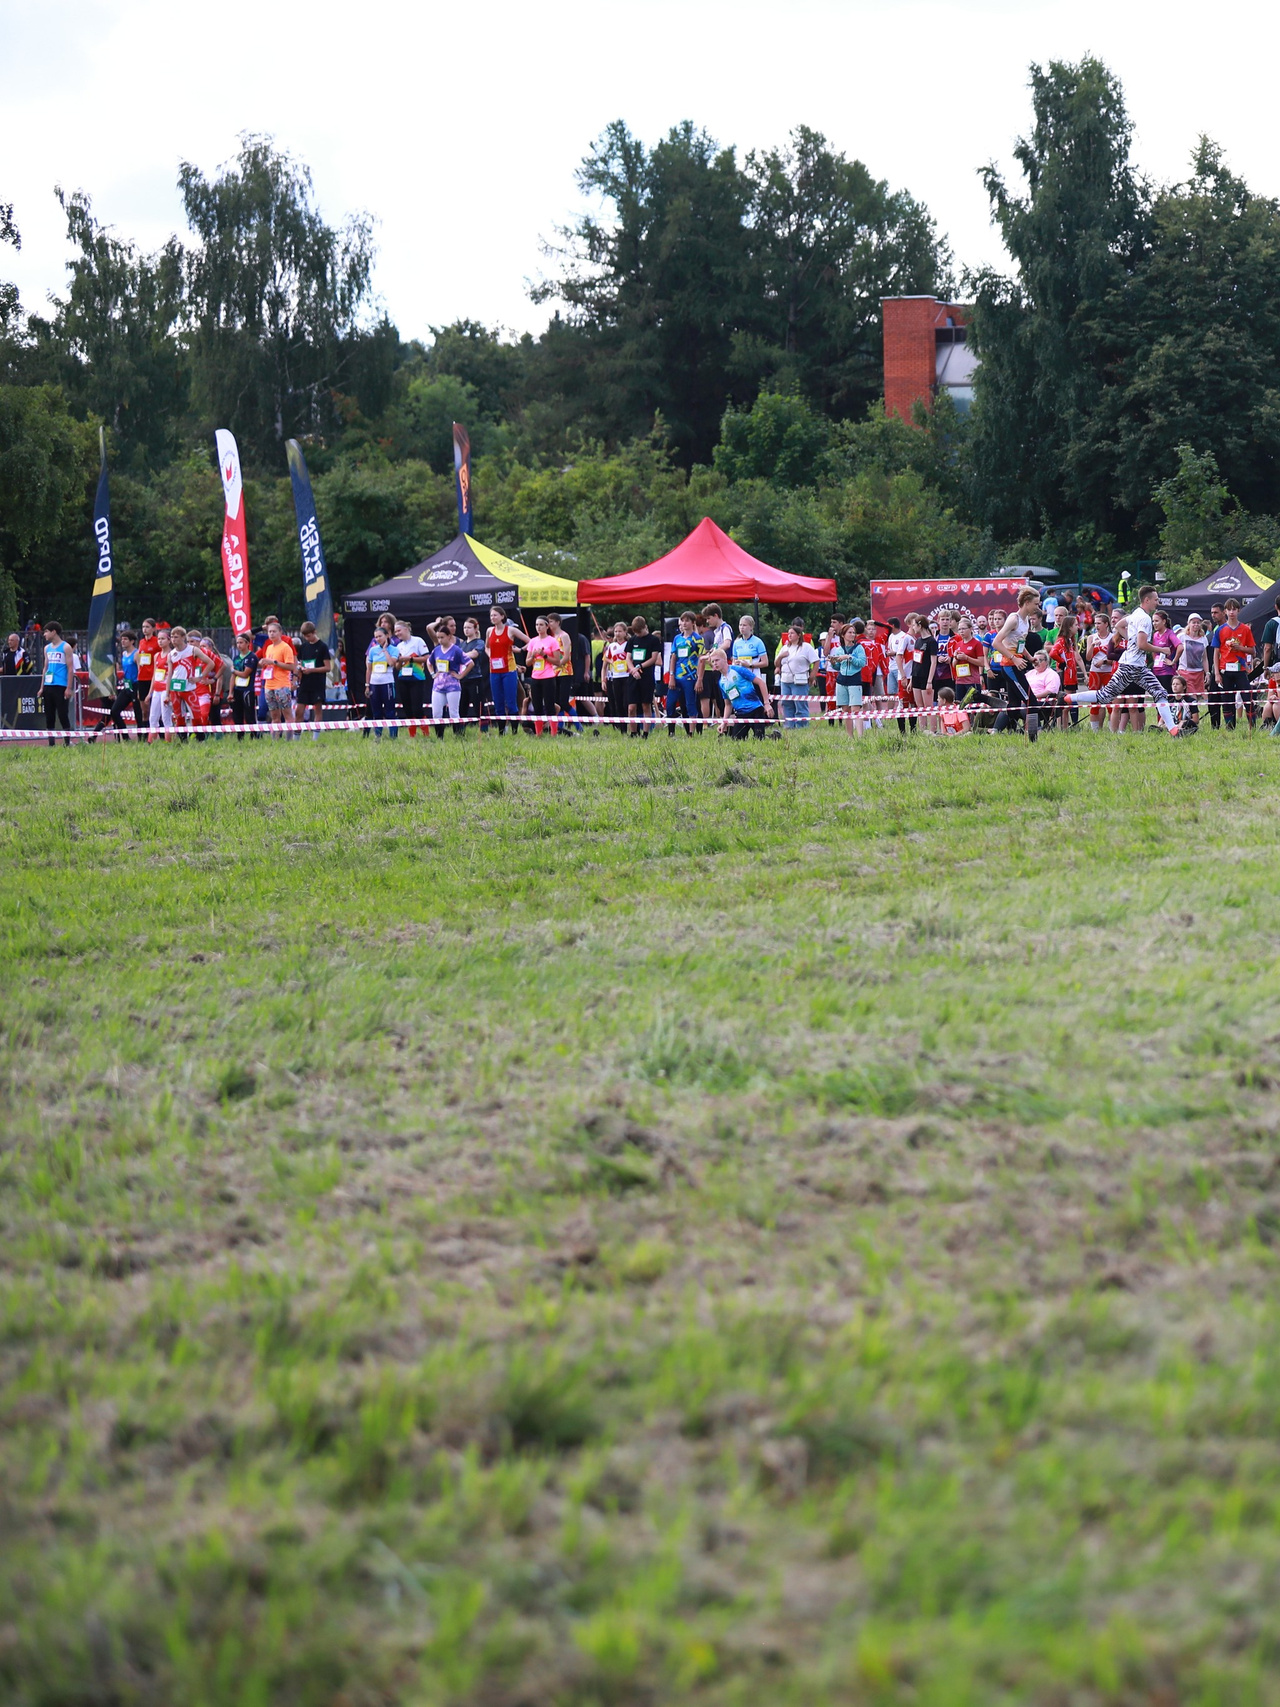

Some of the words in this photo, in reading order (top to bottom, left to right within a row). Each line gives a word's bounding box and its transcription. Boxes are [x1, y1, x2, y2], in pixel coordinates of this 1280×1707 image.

[927, 602, 960, 621] ВЕНСТВО
[22, 697, 36, 705] OPEN
[22, 705, 36, 714] BAND
